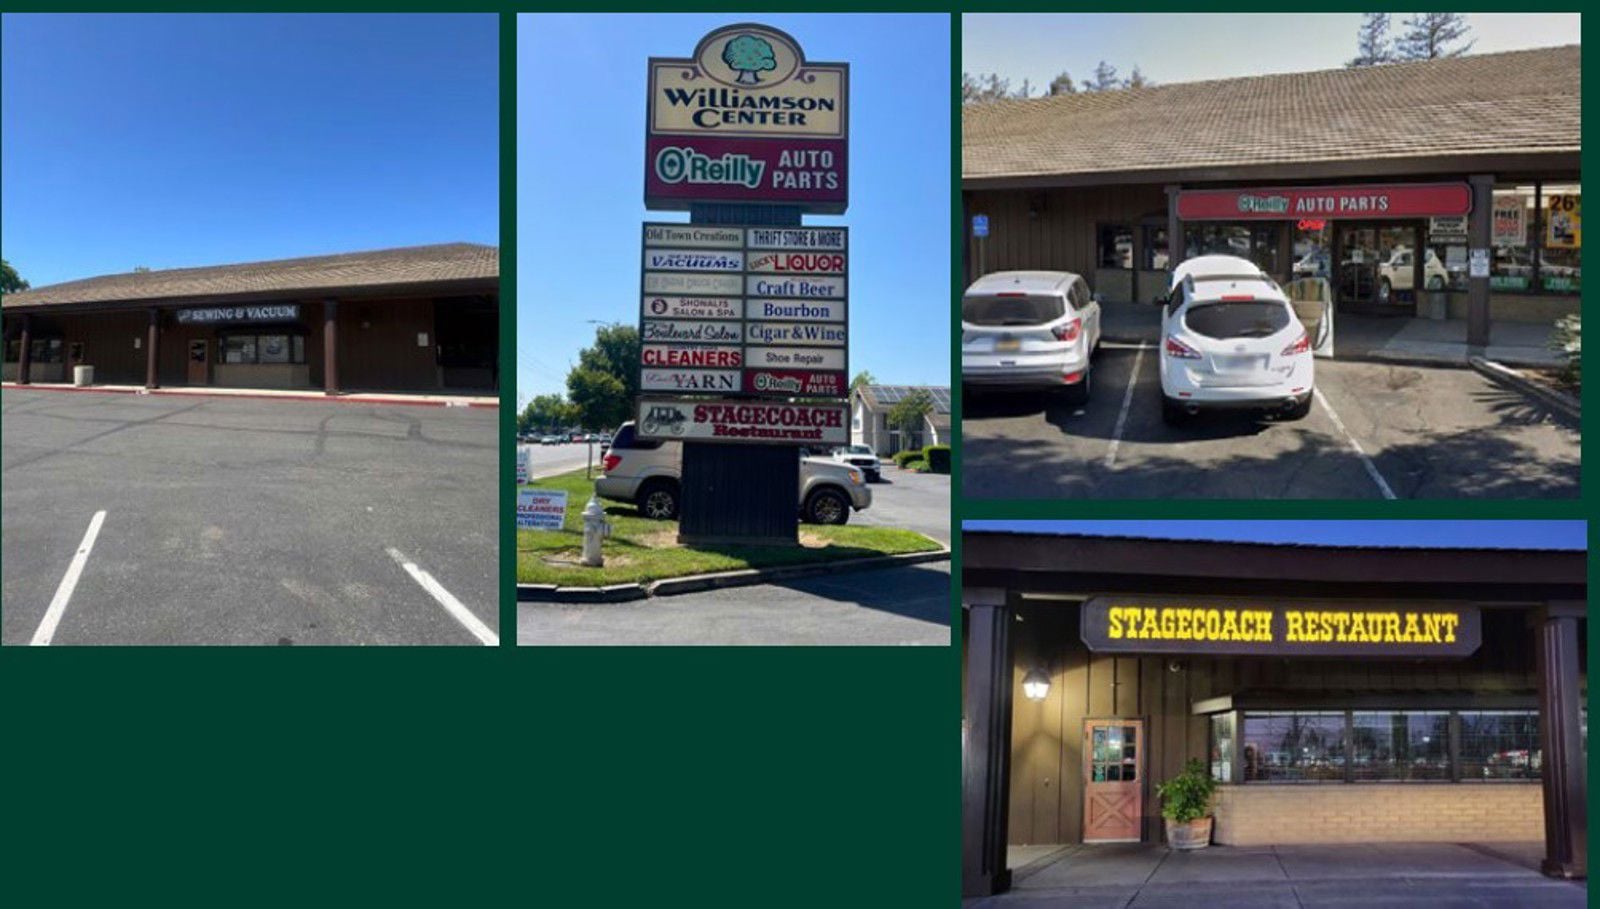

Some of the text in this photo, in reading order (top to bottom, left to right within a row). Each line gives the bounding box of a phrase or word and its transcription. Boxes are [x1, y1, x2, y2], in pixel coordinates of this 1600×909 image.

[692, 108, 807, 129] CENTER
[656, 146, 833, 188] O'Reilly AUTO
[772, 171, 838, 189] PARTS
[1296, 197, 1334, 212] AUTO
[1340, 196, 1388, 212] PARTS
[647, 228, 739, 242] Old Town Creations
[754, 231, 781, 246] THRIFT
[783, 231, 808, 246] STORE
[810, 231, 815, 246] &
[652, 255, 739, 268] VACUUMS
[775, 254, 844, 271] LIQUOR
[757, 281, 835, 295] Craft Beer
[192, 308, 234, 320] SEWING
[246, 305, 297, 318] VACUUM
[673, 307, 705, 316] SALON
[716, 308, 735, 316] SPA
[764, 302, 830, 317] Bourbon
[749, 324, 790, 344] Cigar
[643, 349, 741, 366] CLEANERS
[766, 352, 824, 365] Shoe Repair
[674, 374, 734, 389] YARN
[809, 374, 836, 384] AUTO
[806, 384, 838, 394] PARTS
[693, 404, 843, 427] STAGECOACH
[713, 424, 823, 439] Restaurant
[517, 504, 564, 513] CLEANERS
[1108, 606, 1459, 644] STAGECOACH RESTAURANT
